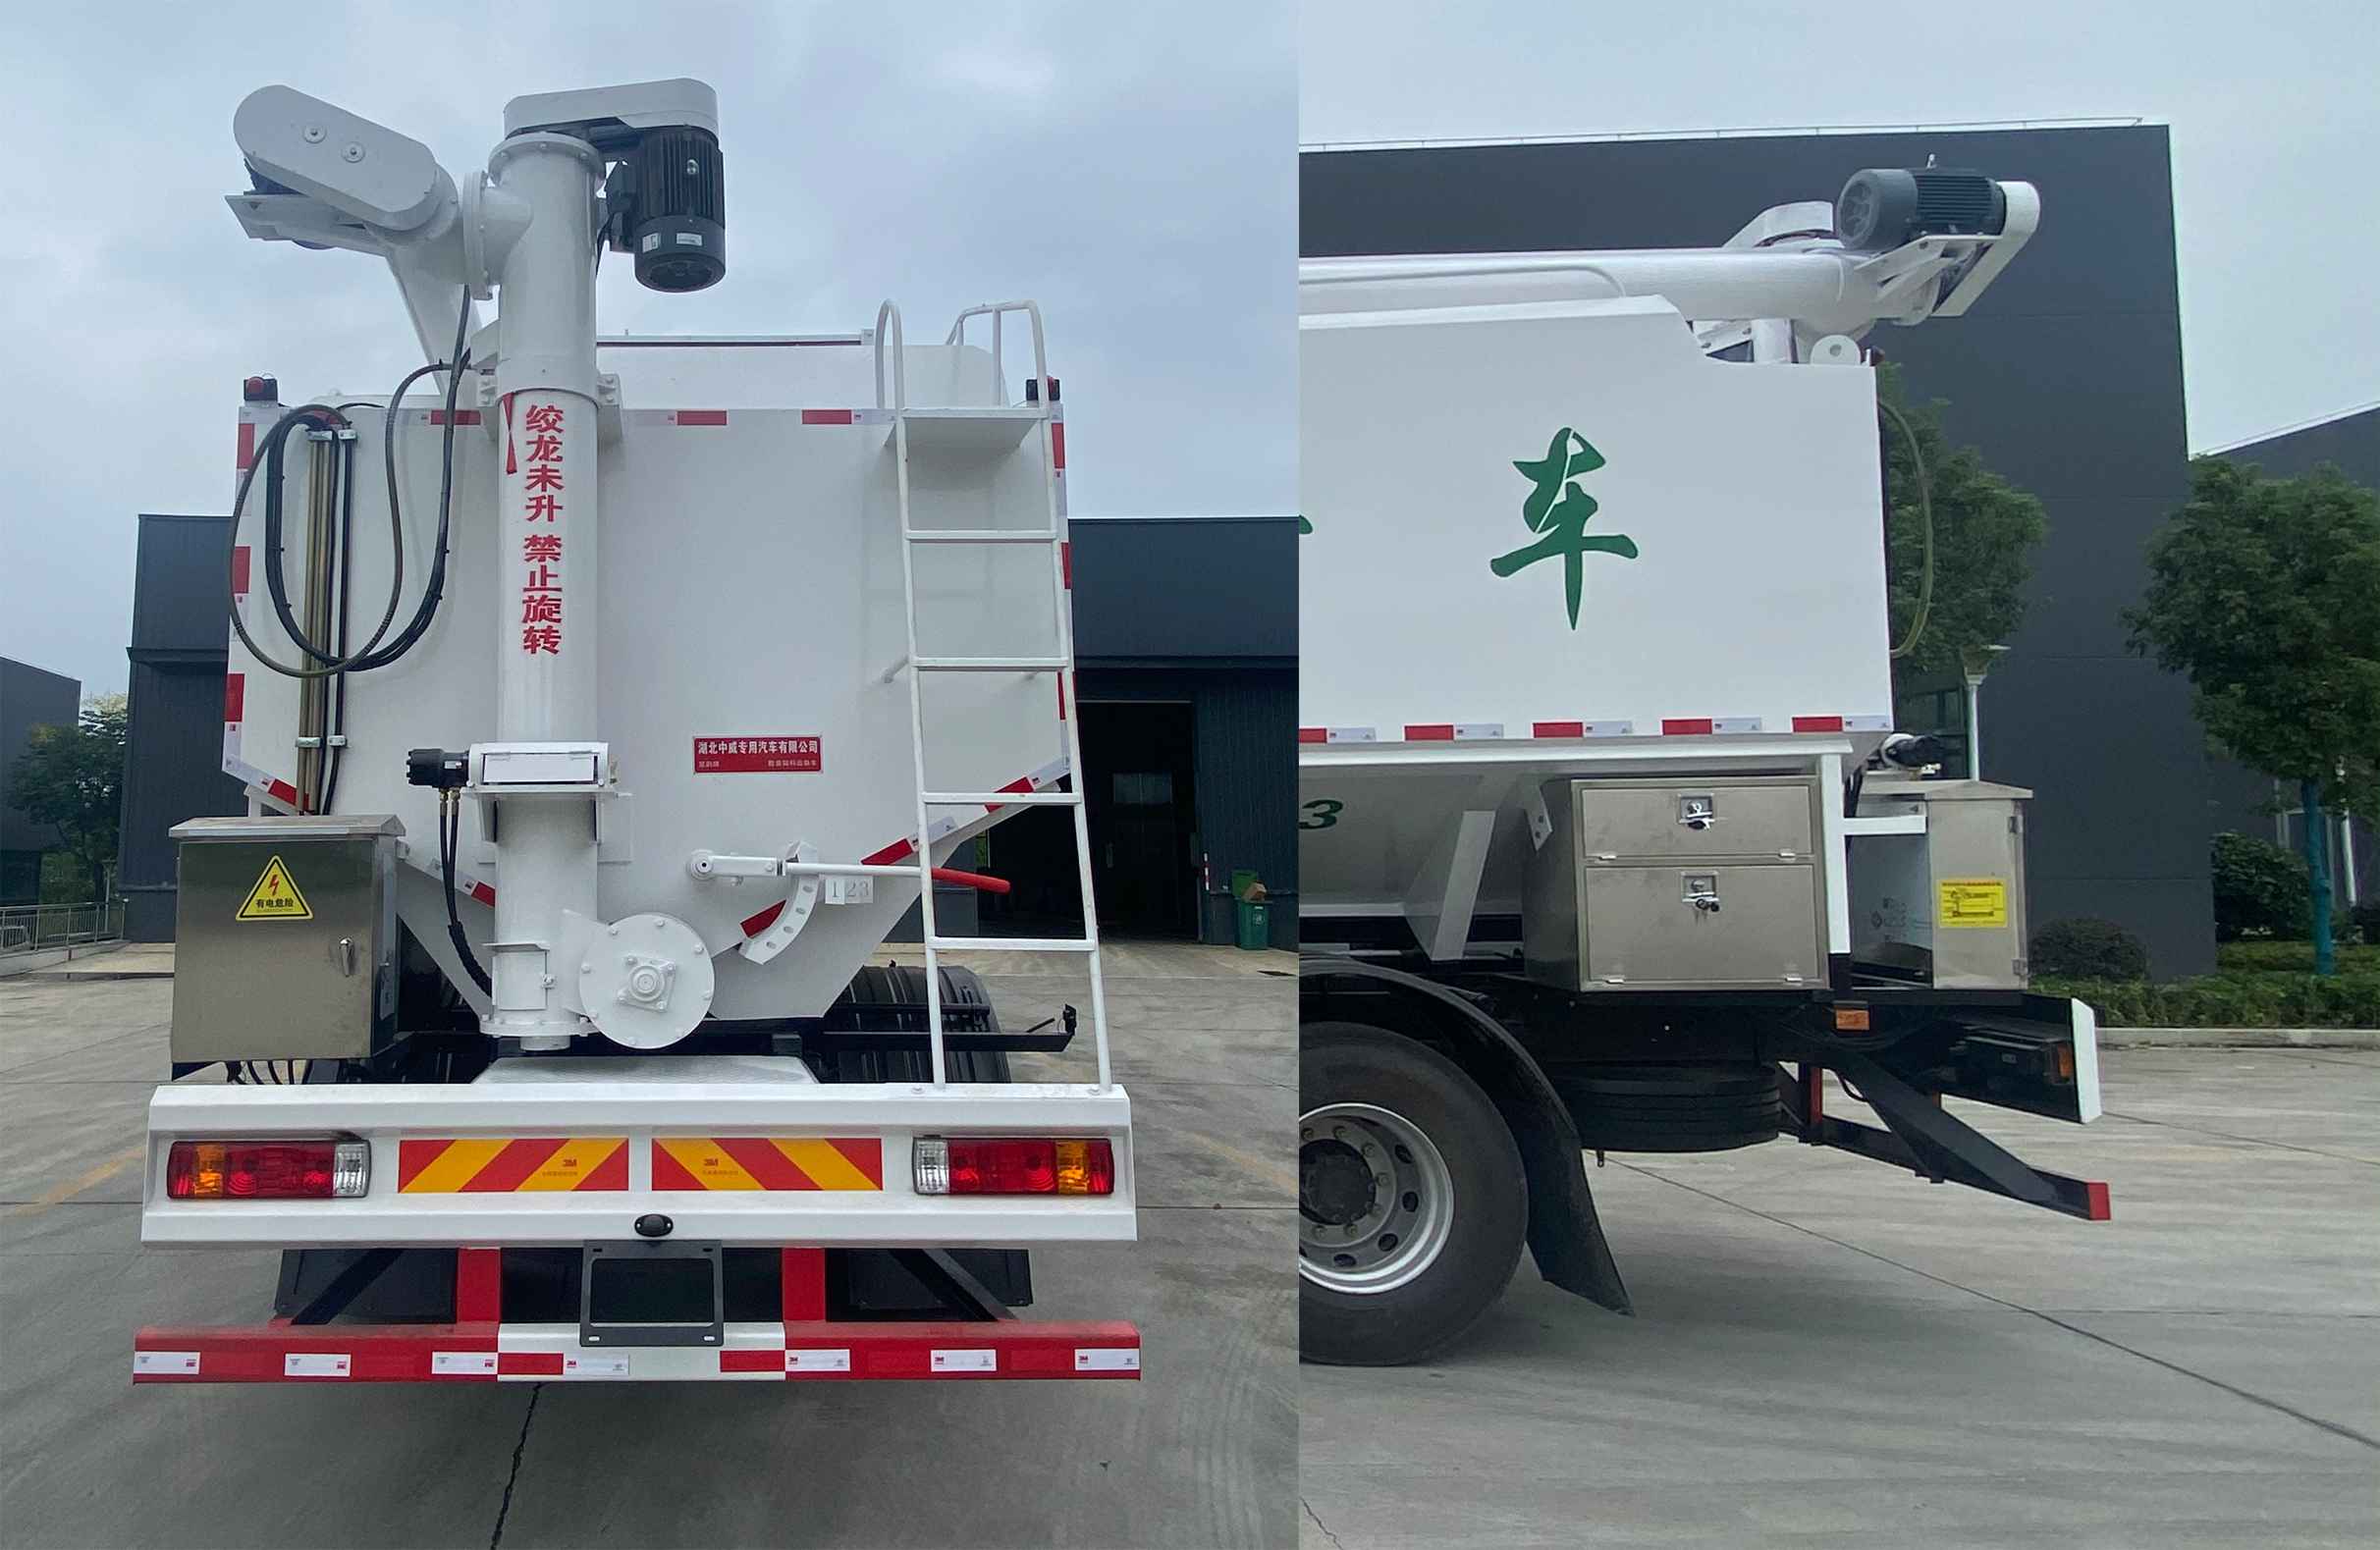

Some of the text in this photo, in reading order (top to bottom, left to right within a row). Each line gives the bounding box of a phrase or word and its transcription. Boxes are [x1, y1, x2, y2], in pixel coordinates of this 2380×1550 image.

[521, 404, 565, 655] 绞龙未升 禁止旋转
[1489, 426, 1639, 631] 车
[698, 740, 818, 754] 湖北中威专用汽车有限公司
[255, 898, 294, 908] 有电危险
